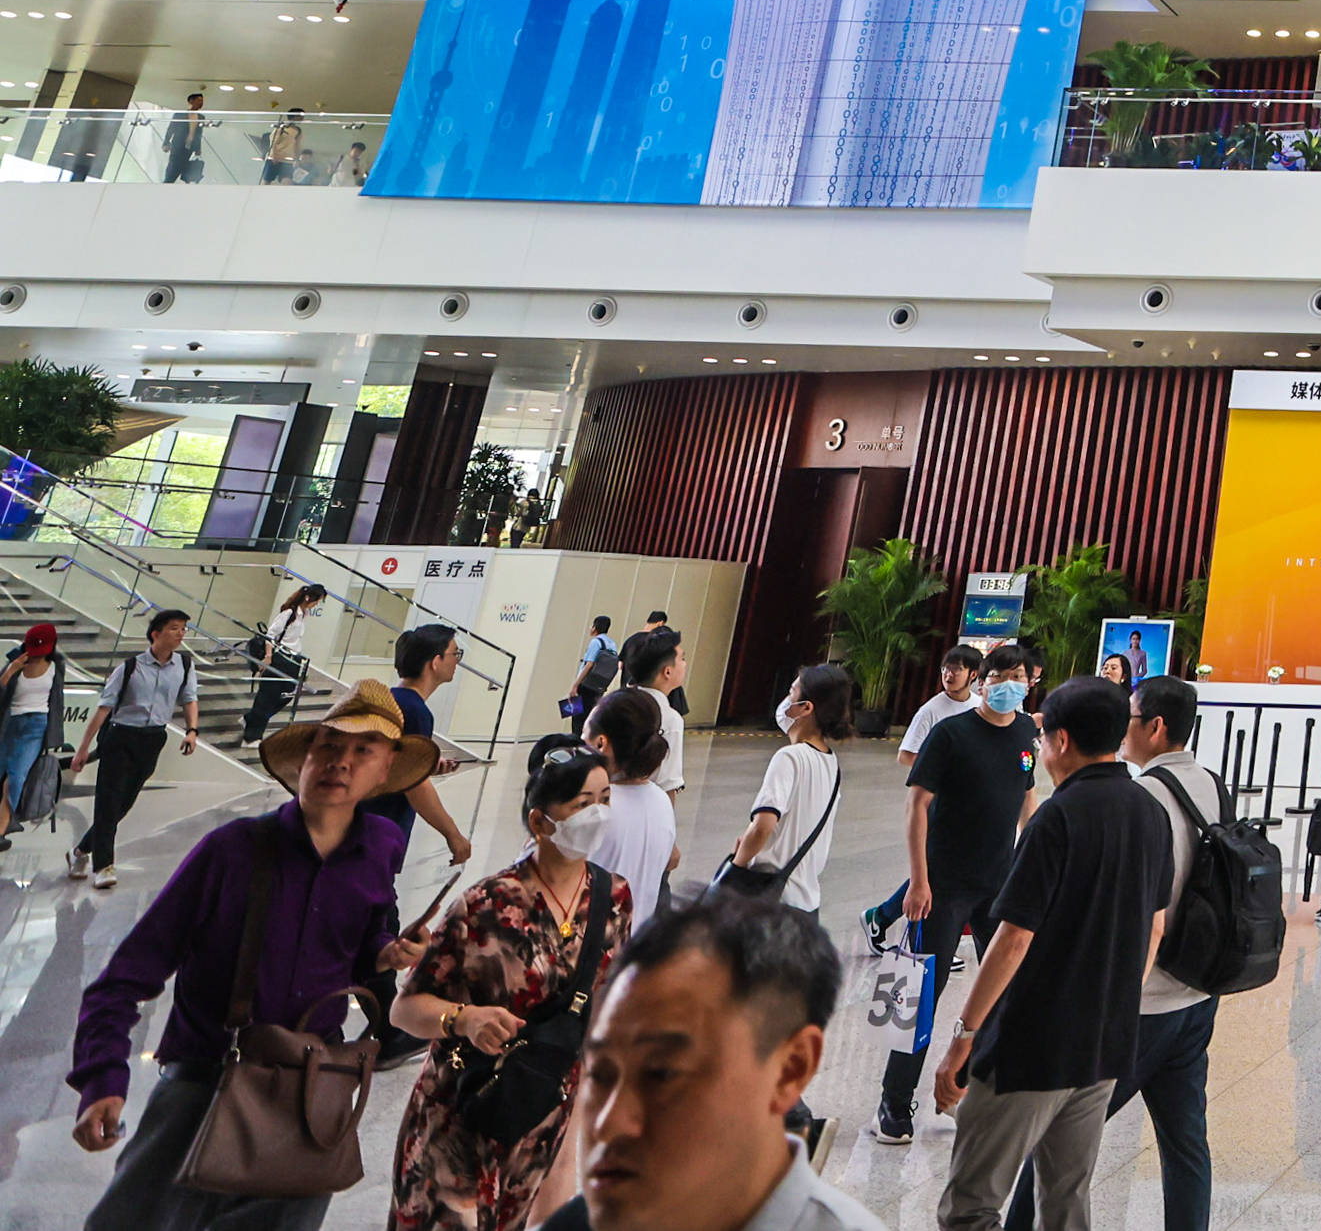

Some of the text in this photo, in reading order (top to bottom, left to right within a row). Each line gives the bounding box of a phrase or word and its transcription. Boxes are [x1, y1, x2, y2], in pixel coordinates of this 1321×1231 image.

[825, 418, 844, 450] 3
[881, 425, 904, 440] 单号
[424, 560, 485, 578] 医疗点
[499, 612, 526, 623] WAIC
